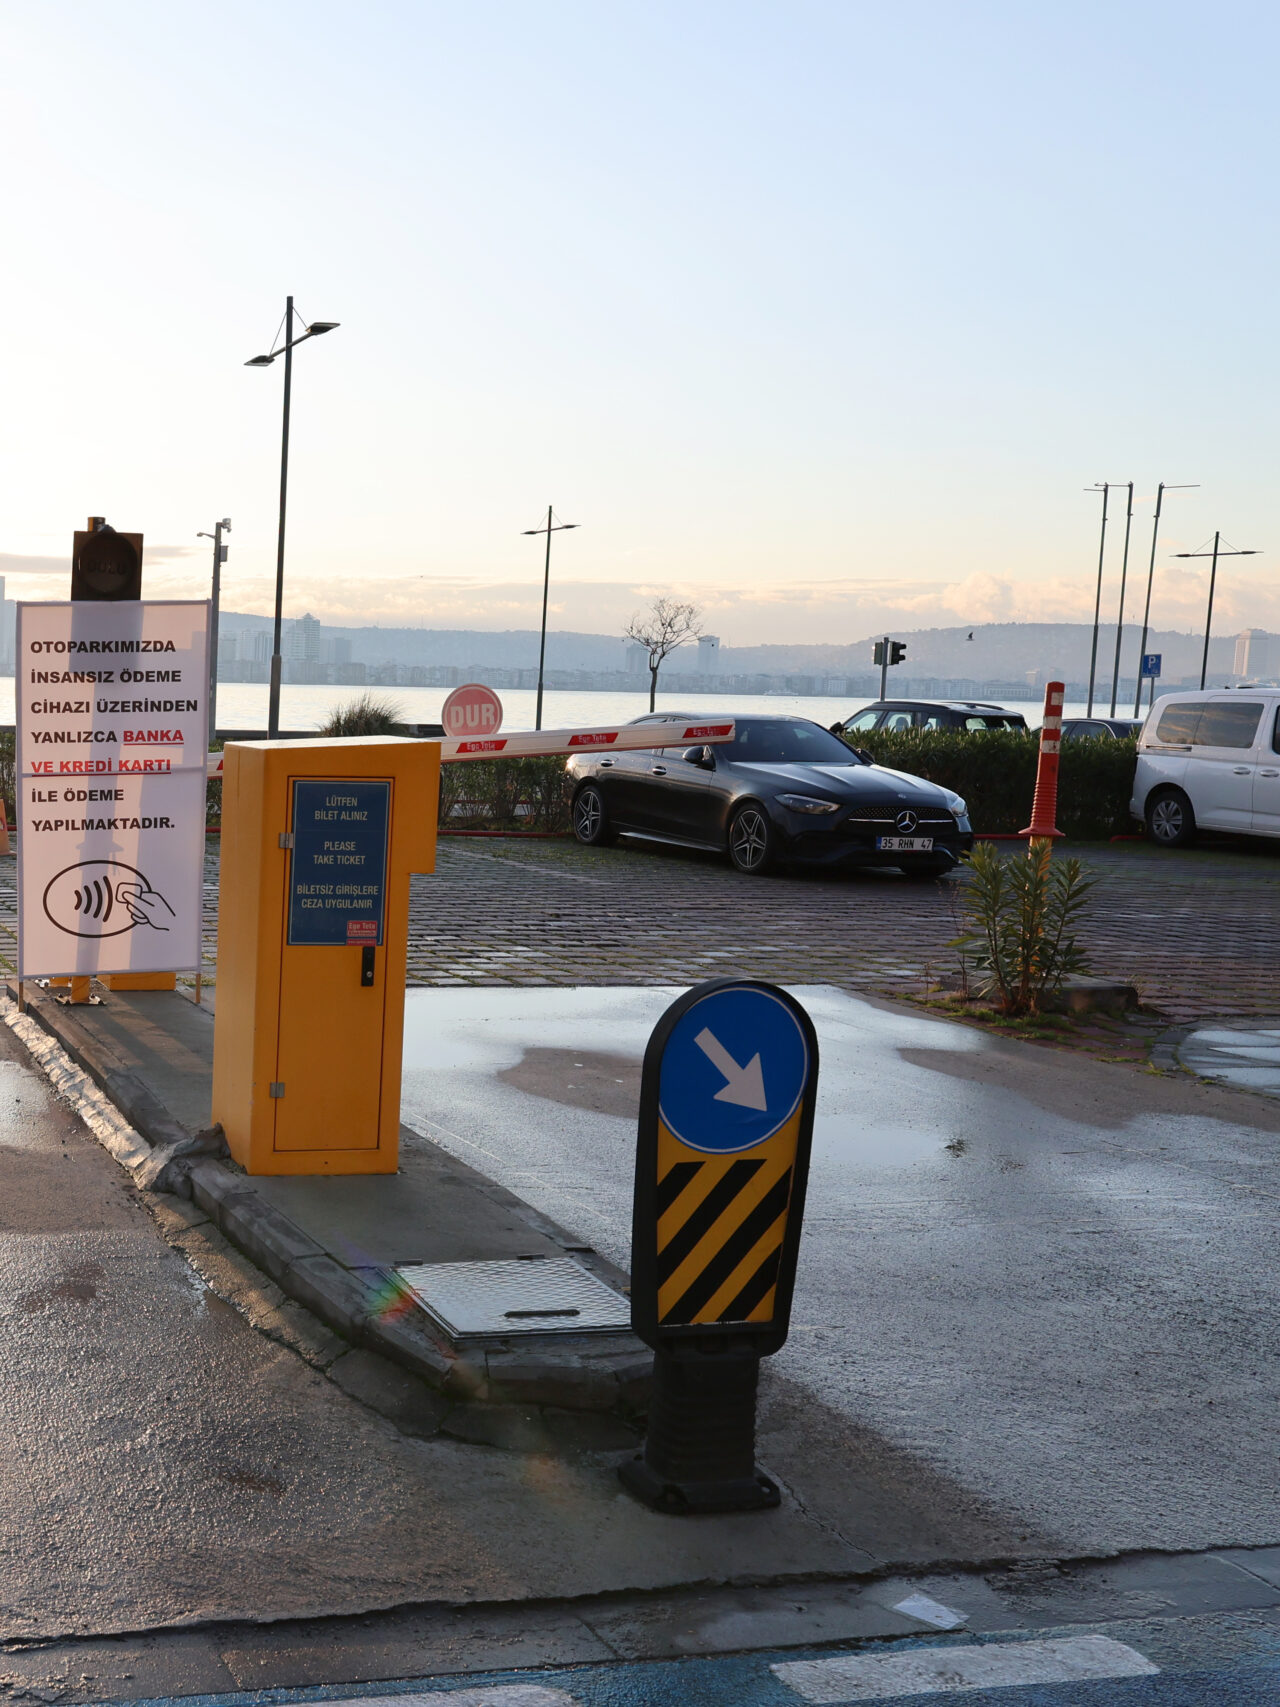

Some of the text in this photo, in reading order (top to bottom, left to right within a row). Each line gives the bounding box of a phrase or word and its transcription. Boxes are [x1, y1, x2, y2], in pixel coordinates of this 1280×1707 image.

[30, 640, 176, 653] OTOPARKIMIZDA
[1148, 655, 1157, 669] P
[31, 668, 181, 683] İNSANSIZ ÖDEME
[31, 698, 198, 713] CİHAZI ÜZERİNDEN
[450, 703, 495, 728] DUR
[31, 730, 184, 744] YANLIZCA BANKA
[31, 757, 171, 773] VE KREDİ KARTI
[32, 788, 124, 802] İLE ÖDEME
[326, 795, 358, 807] LÜTFEN
[314, 808, 368, 820] BİLET ALINIZ
[32, 817, 175, 831] YAPILMAKTADIR.
[324, 841, 356, 850] PLEASE
[882, 838, 893, 848] 35
[898, 839, 915, 848] RHN
[921, 839, 932, 849] 47
[313, 855, 365, 865] TAKE TICKET
[297, 883, 379, 896] BİLETSİZ GİRİŞLERE
[301, 899, 373, 909] CEZA UYGULANIR
